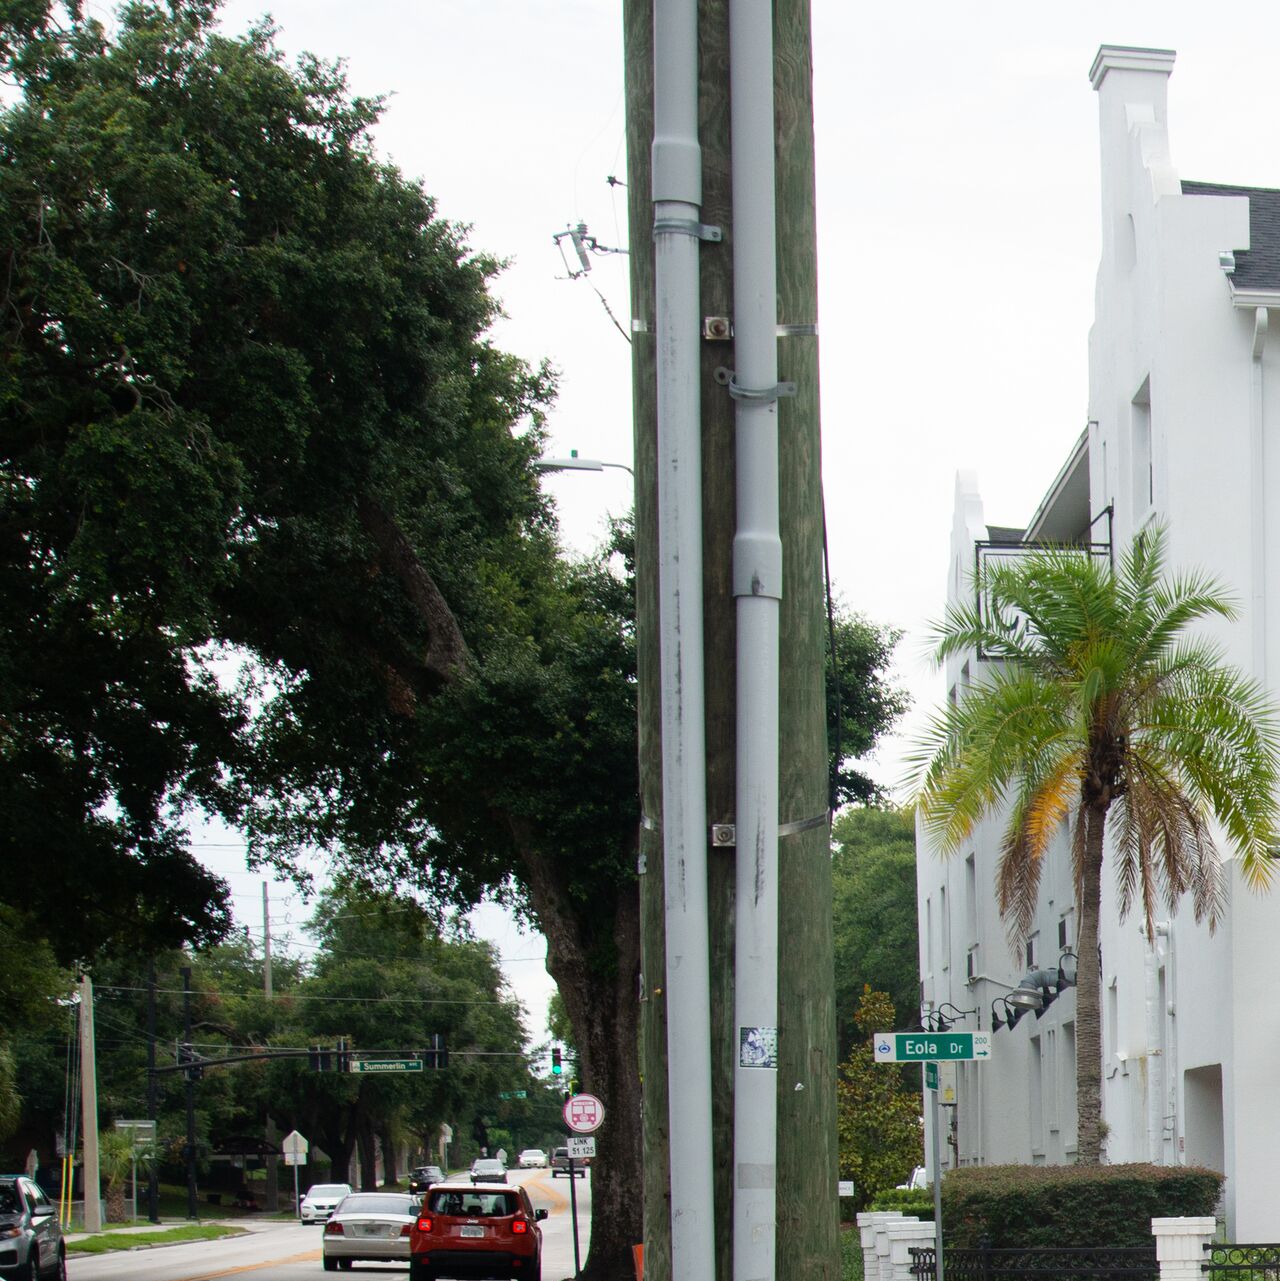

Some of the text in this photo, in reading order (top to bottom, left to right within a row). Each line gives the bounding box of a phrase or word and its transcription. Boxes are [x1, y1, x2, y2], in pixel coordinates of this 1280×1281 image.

[905, 1040, 964, 1055] Eola Dr
[363, 1062, 406, 1071] Summerlin
[573, 1138, 588, 1146] LINK
[582, 1146, 595, 1154] 125
